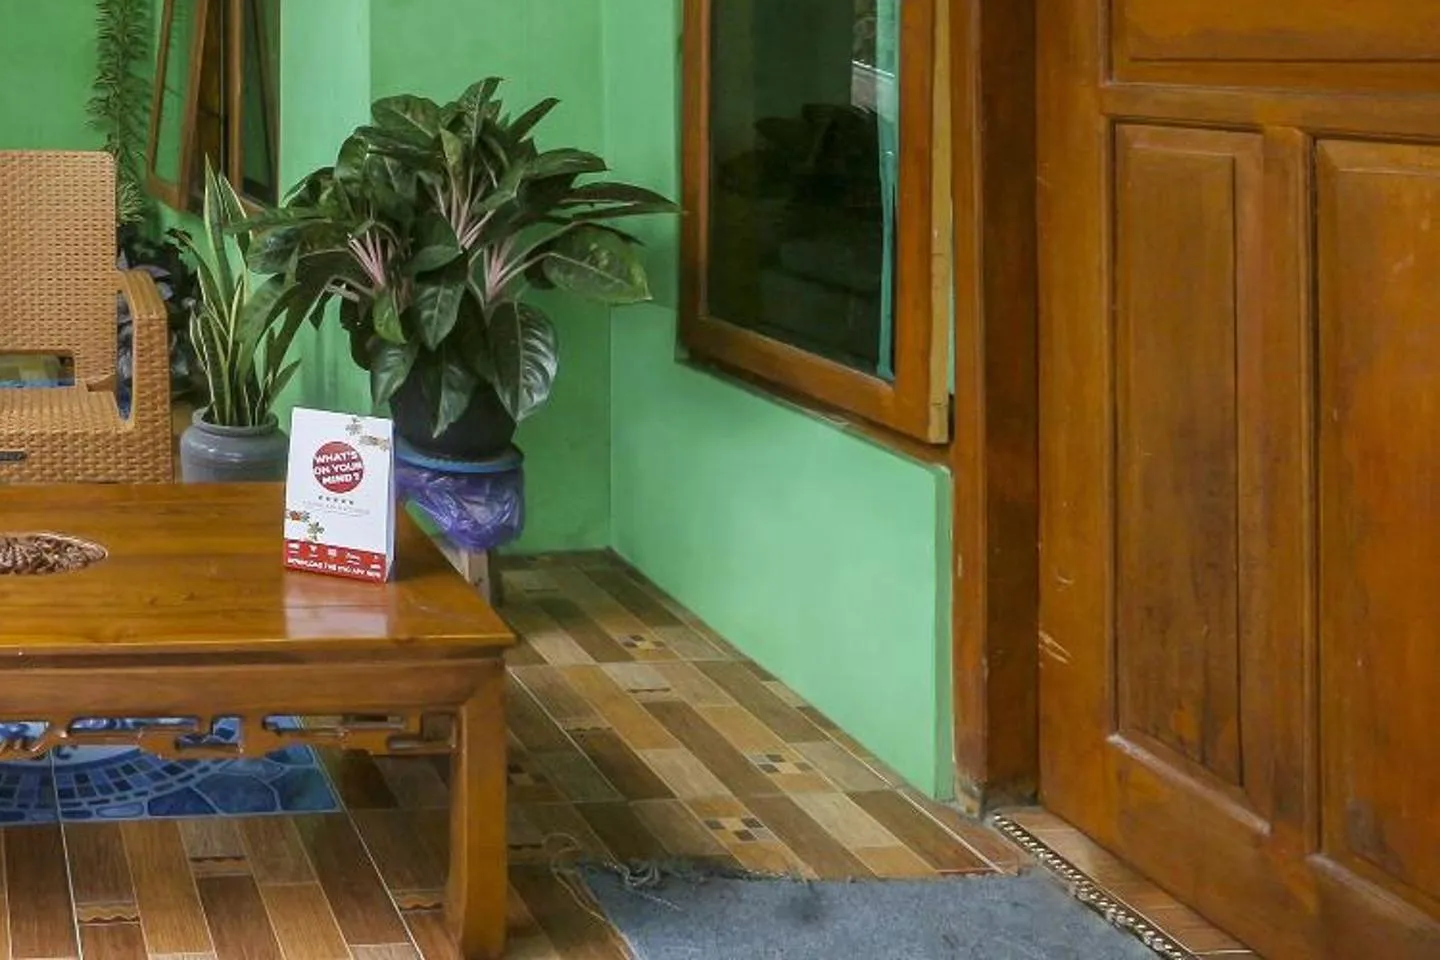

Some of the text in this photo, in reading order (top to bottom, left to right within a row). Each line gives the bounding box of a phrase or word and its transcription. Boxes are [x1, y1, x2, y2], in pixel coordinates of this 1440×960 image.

[316, 451, 358, 463] WHAT'S
[314, 462, 362, 475] ON YOUR
